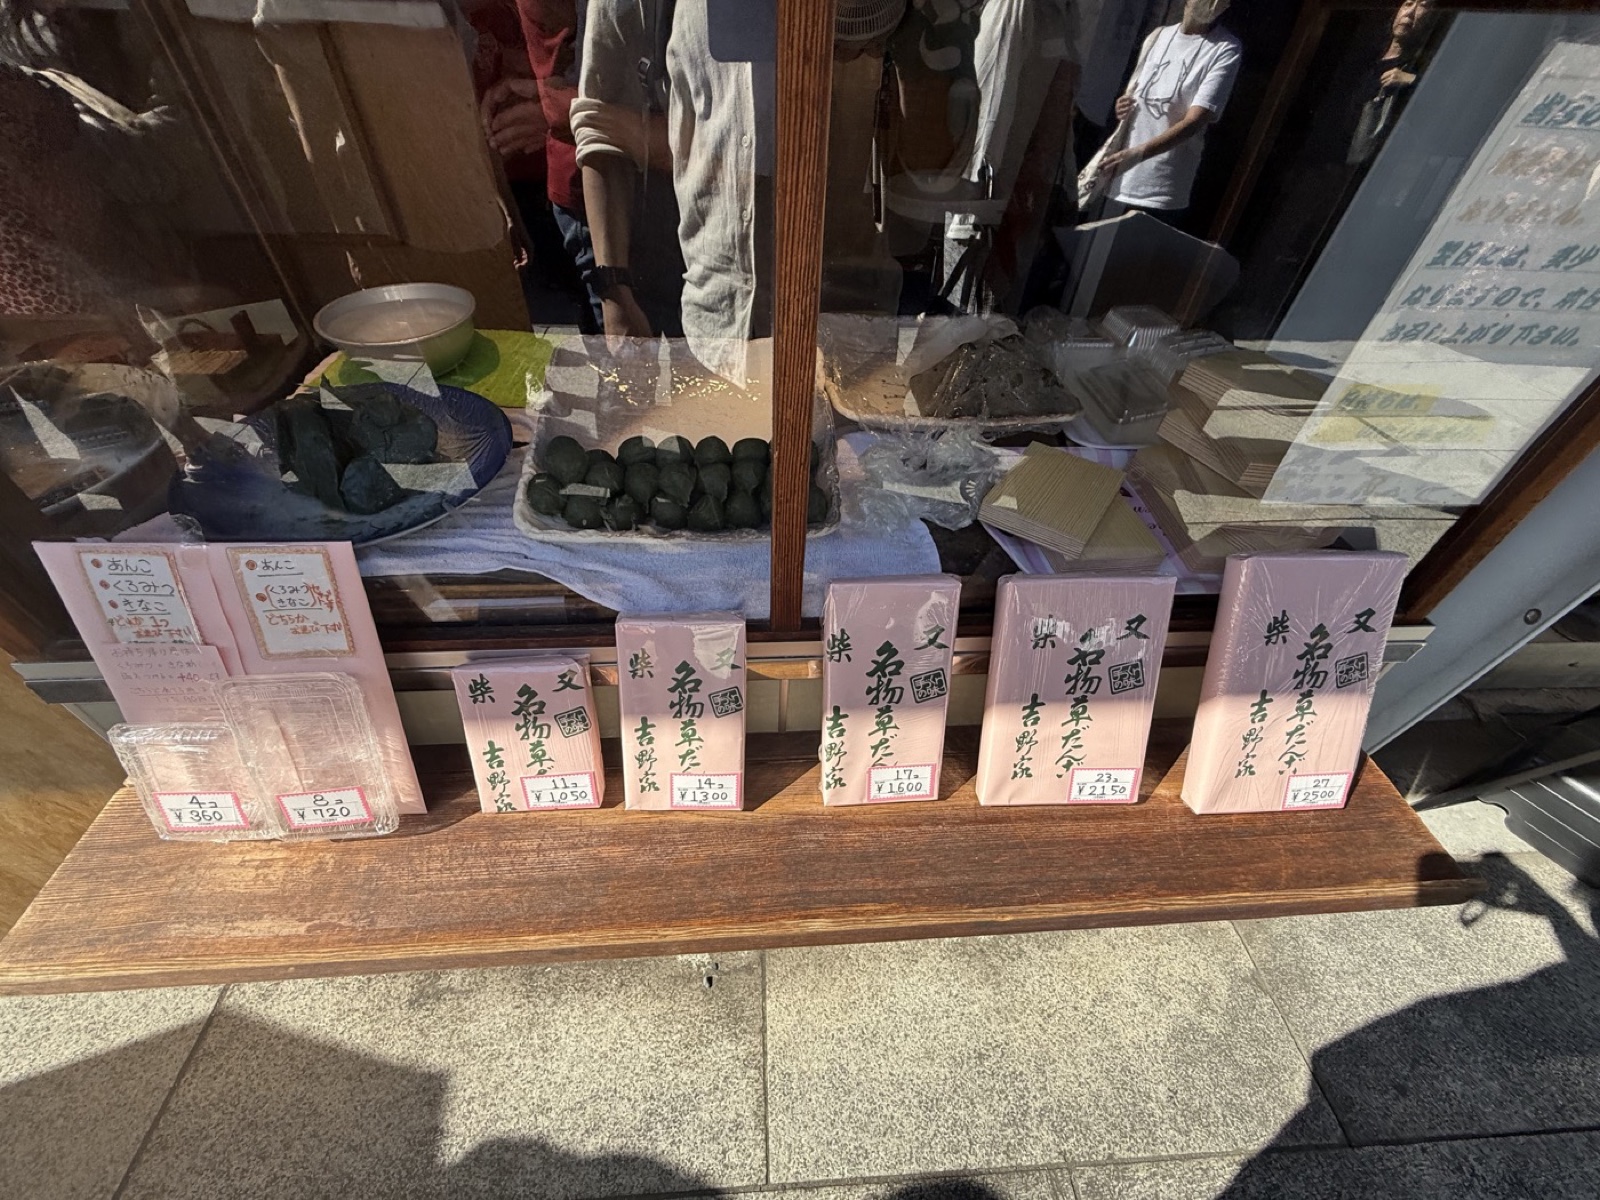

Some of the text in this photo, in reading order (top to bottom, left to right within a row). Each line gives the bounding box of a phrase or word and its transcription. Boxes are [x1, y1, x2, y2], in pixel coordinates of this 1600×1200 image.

[107, 558, 152, 573] あんこ
[261, 559, 295, 571] あんこ
[113, 580, 175, 596] くろみつ
[122, 599, 167, 612] きなこ
[278, 598, 310, 608] きなこ
[826, 624, 950, 663] 柴 又
[1030, 614, 1150, 649] 柴 又
[1264, 608, 1378, 646] 柴 又
[628, 648, 742, 679] 柴 又
[468, 669, 586, 705] 柴 又
[1278, 623, 1334, 775] 名物草だんご
[825, 705, 849, 790] 吉野家
[1011, 693, 1046, 780] 吉野家
[1235, 689, 1273, 778] 吉野家
[634, 716, 660, 793] 吉野家
[482, 740, 518, 812] 吉野家
